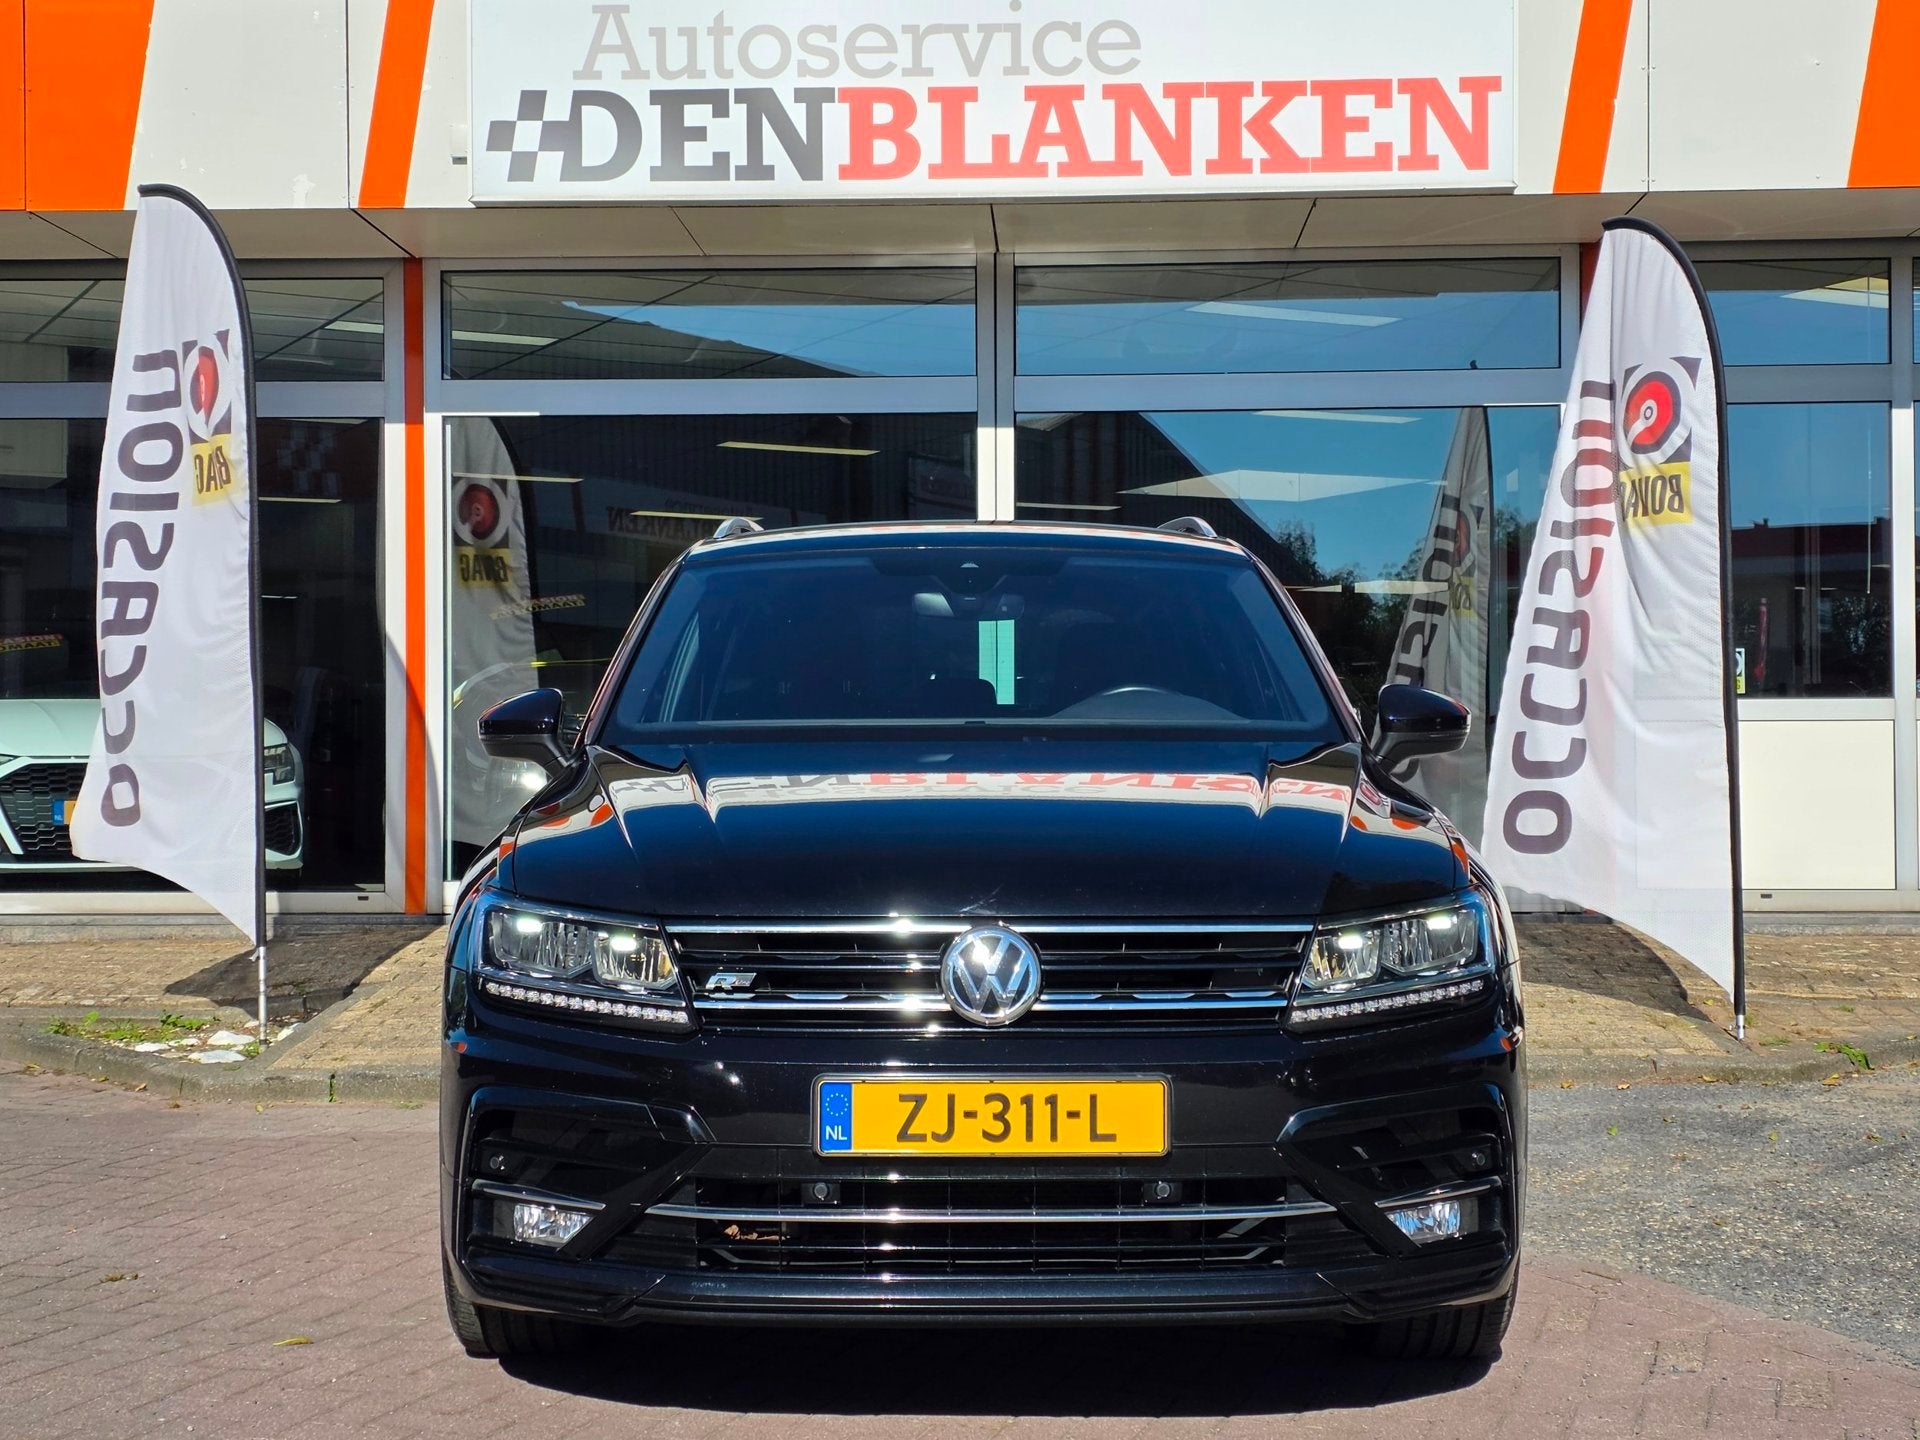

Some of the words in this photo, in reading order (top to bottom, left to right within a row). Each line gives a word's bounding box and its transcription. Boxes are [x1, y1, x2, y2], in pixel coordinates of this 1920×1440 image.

[572, 0, 1141, 81] Autoservice
[825, 1124, 847, 1141] NL
[896, 1093, 1117, 1143] ZJ-311-L
